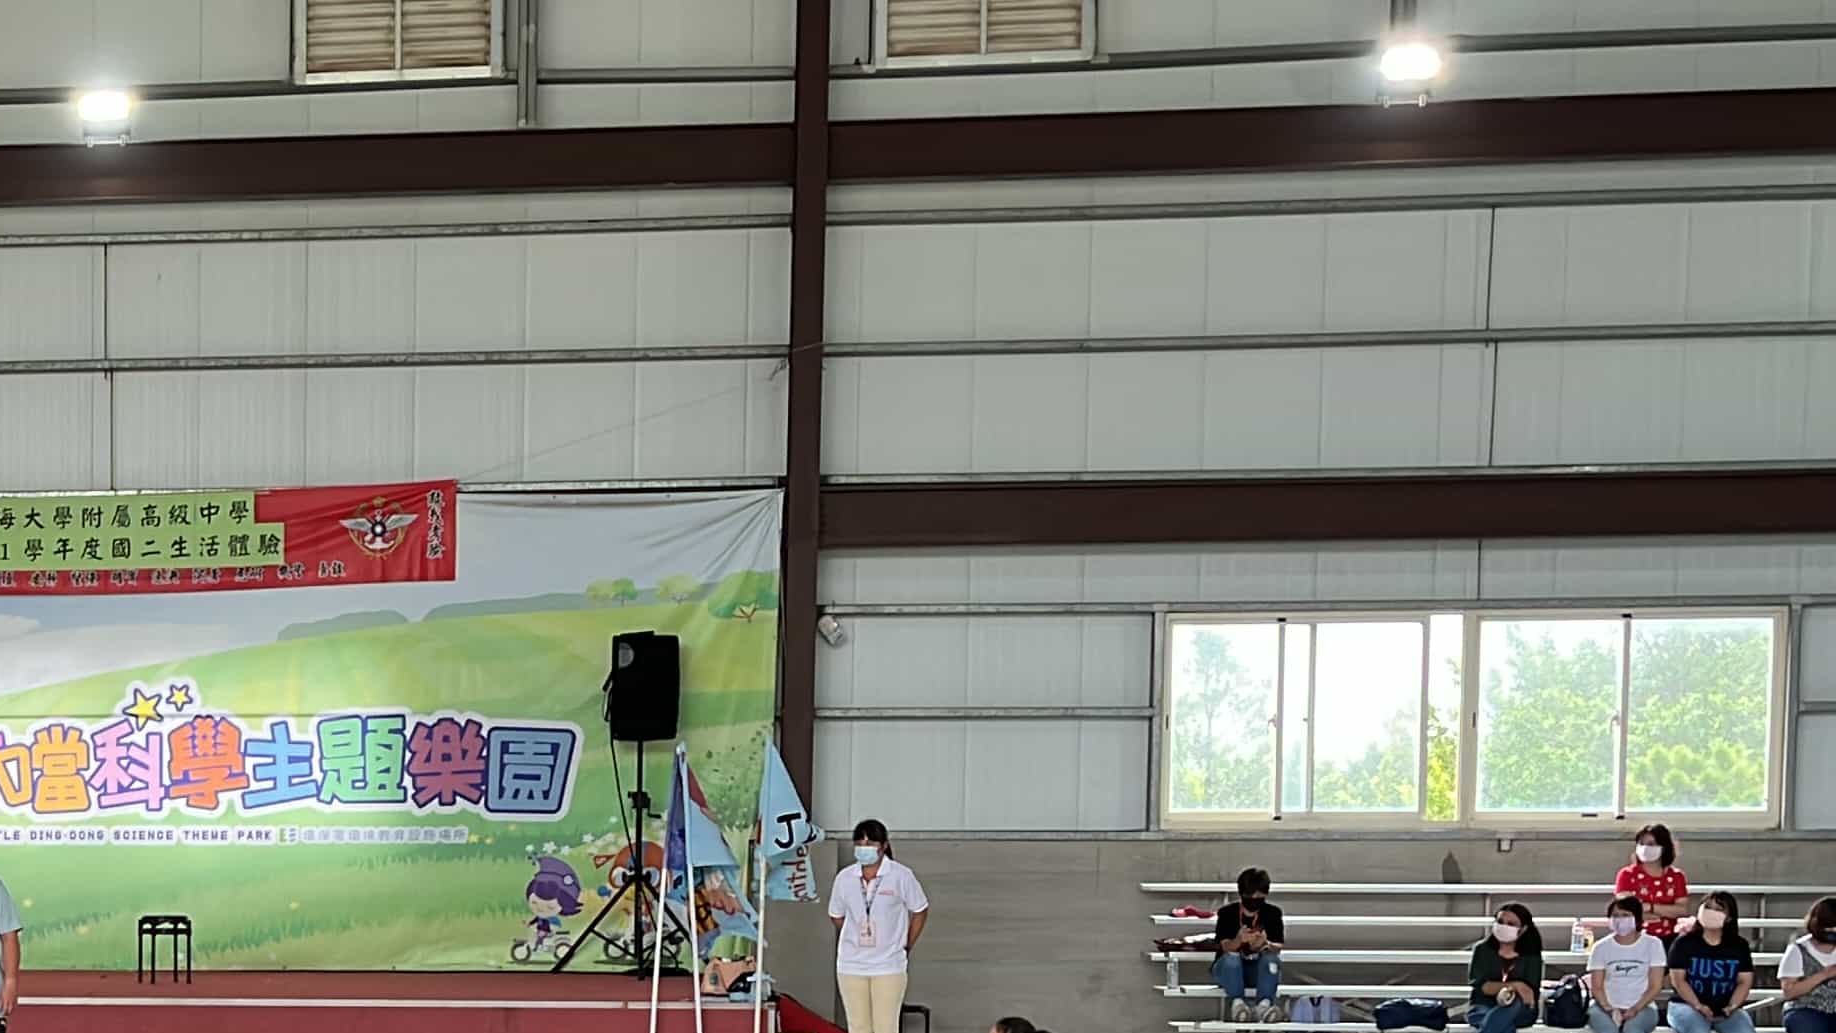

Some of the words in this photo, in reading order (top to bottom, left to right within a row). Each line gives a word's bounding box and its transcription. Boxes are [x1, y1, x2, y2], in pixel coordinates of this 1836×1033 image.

[113, 830, 174, 841] SCIENCE
[183, 830, 228, 841] THEME
[237, 830, 272, 841] PARK
[1689, 957, 1741, 978] JUST
